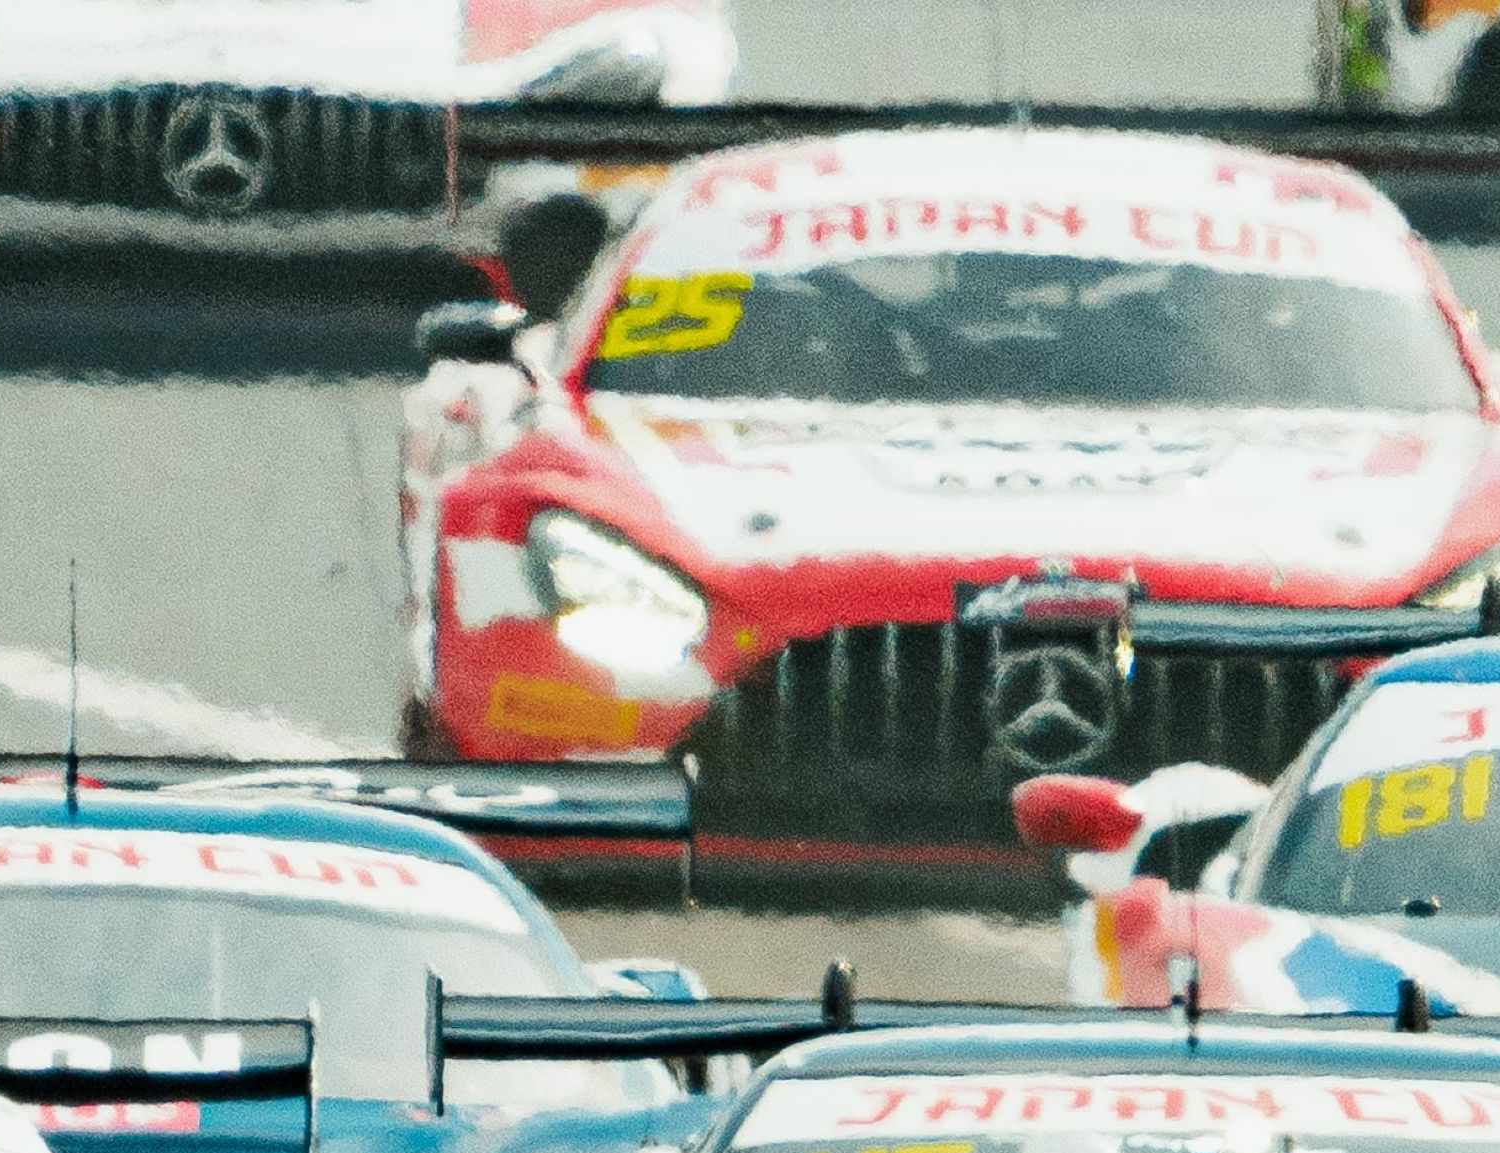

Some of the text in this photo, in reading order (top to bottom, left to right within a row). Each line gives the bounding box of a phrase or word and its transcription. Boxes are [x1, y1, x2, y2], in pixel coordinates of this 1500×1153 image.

[743, 199, 1319, 263] JAPAN CUP
[595, 270, 754, 361] 25
[1338, 756, 1492, 850] 181
[195, 843, 419, 890] CUP
[836, 1085, 1283, 1128] JAPAN
